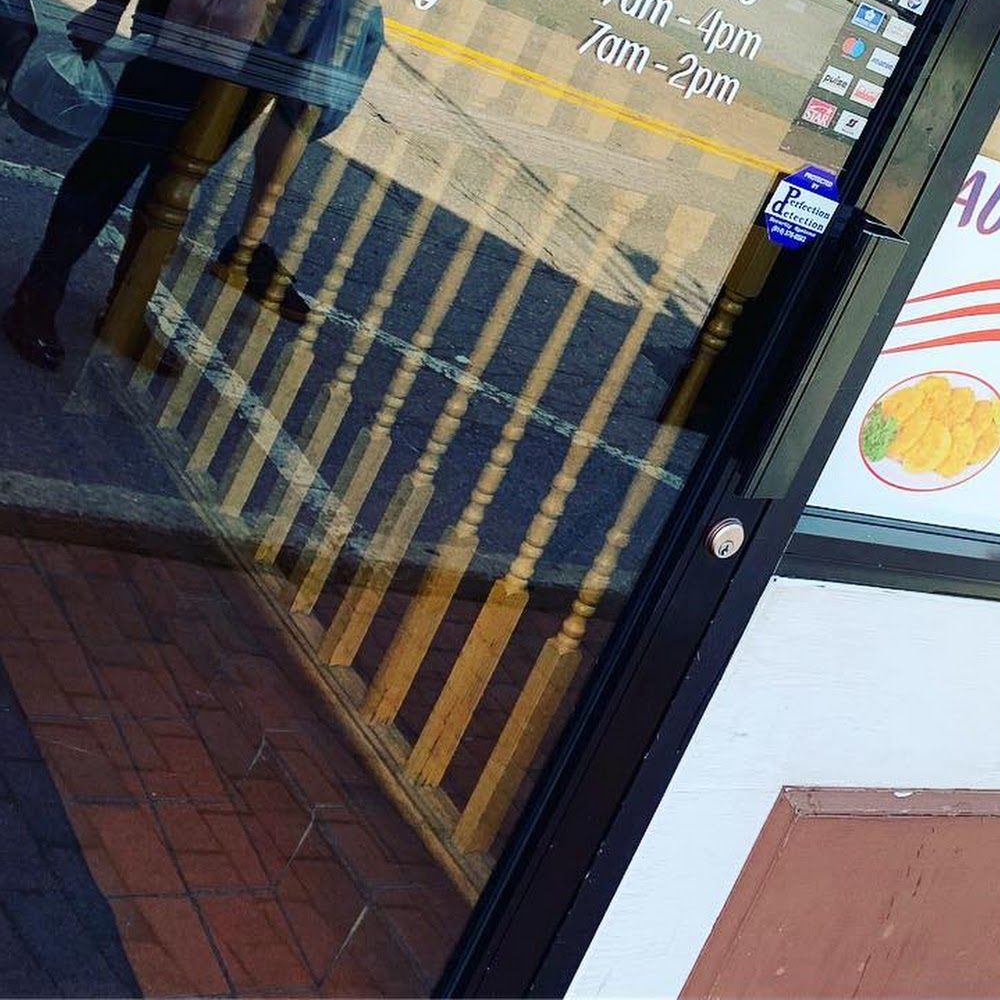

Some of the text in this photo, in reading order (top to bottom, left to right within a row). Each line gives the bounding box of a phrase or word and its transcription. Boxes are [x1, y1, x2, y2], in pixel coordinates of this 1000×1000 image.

[695, 4, 764, 61] 4pm
[577, 20, 652, 77] 7am
[668, 53, 741, 105] 2pm
[822, 73, 848, 89] pulse
[803, 111, 831, 125] STAR
[771, 200, 824, 232] detection
[784, 186, 831, 220] Perfection
